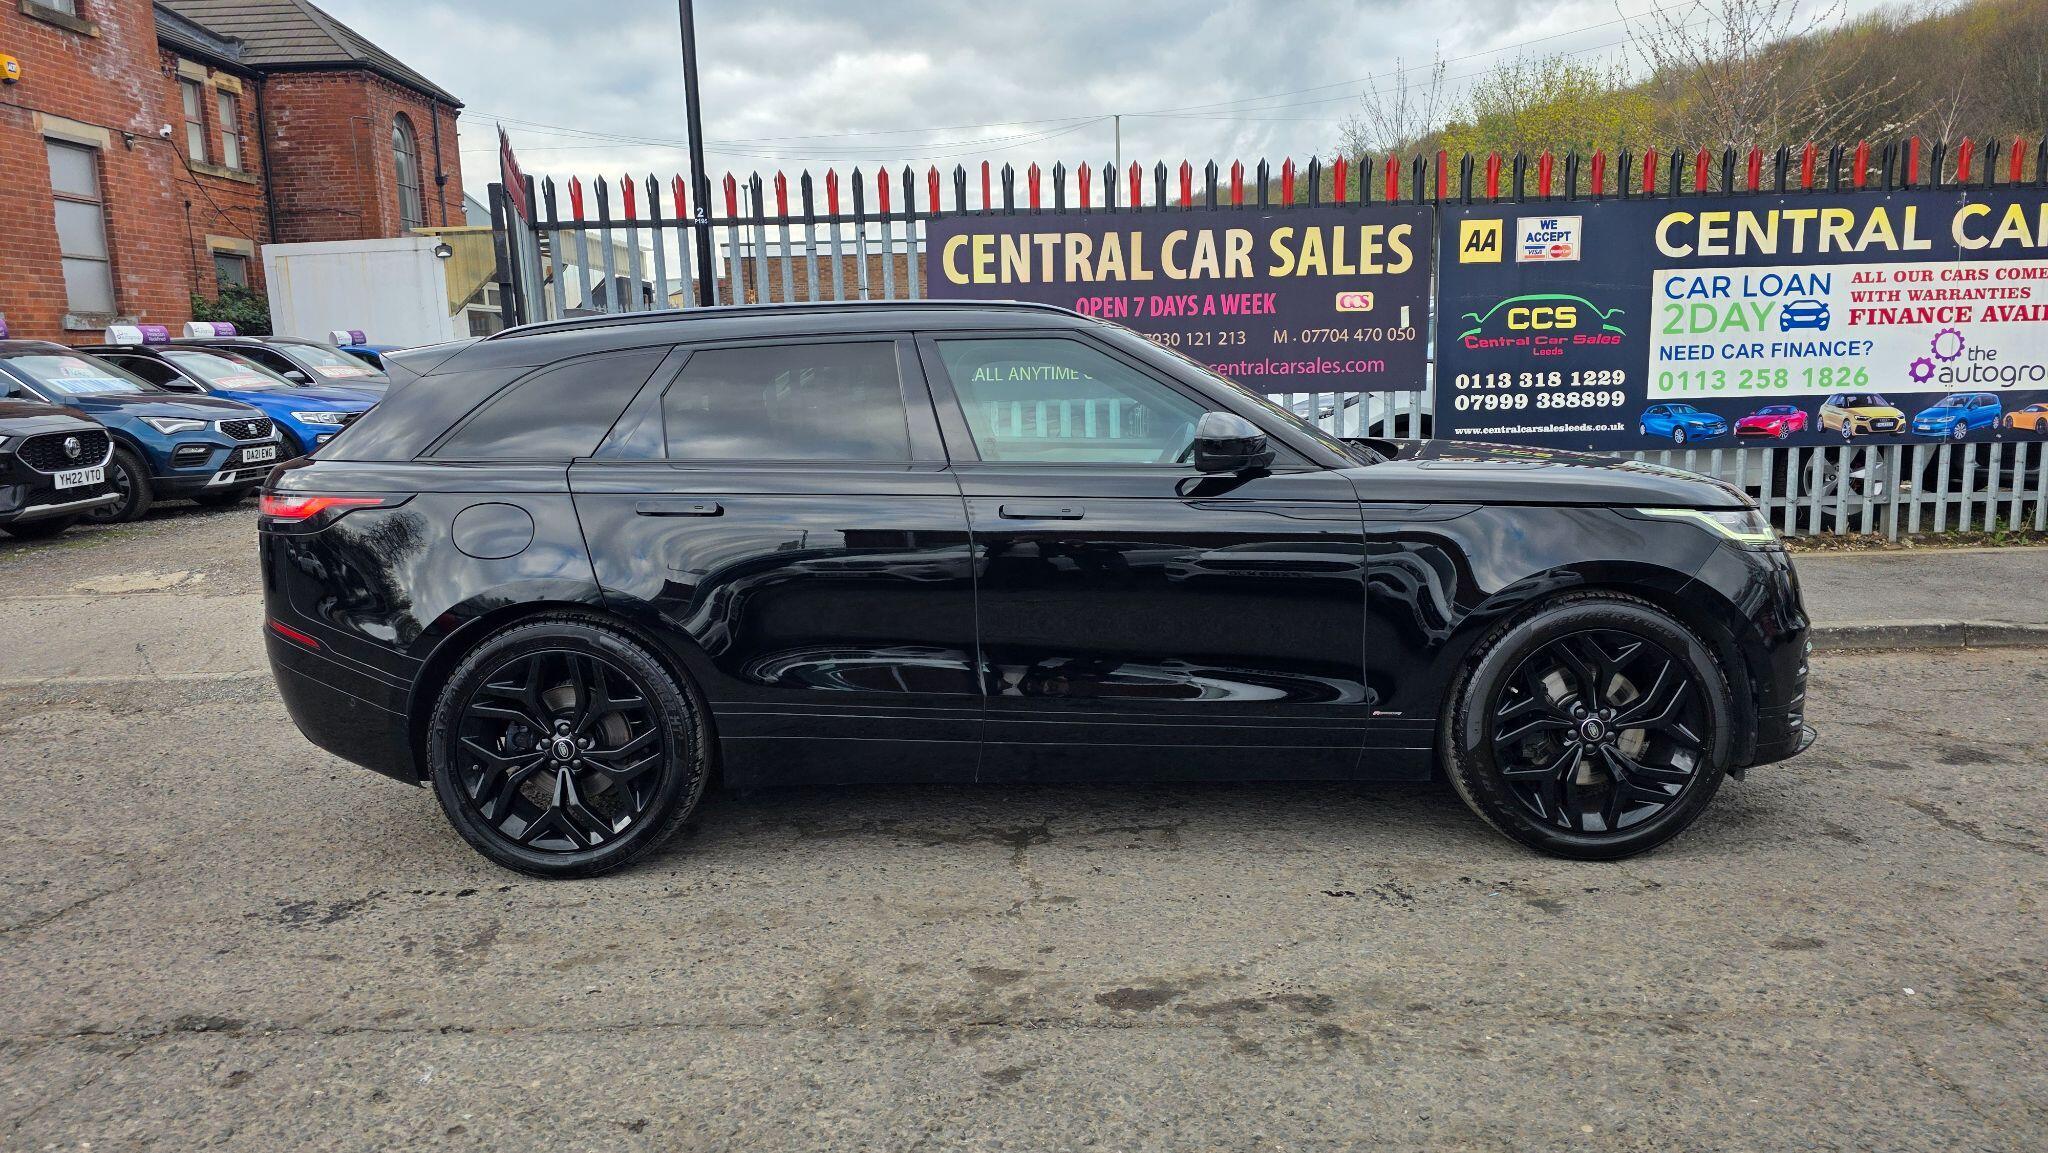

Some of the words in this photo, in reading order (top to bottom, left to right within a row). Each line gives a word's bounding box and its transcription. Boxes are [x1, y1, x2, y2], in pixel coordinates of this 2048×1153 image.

[697, 207, 704, 218] 2
[1540, 220, 1558, 230] WE
[1655, 206, 1931, 258] CENTRAL
[1464, 229, 1496, 252] AA
[1526, 231, 1572, 242] ACCEPT
[942, 231, 1154, 284] CENTRAL
[1161, 228, 1254, 280] CAR
[1268, 224, 1413, 277] SALES
[1851, 271, 1887, 284] ALL
[1893, 270, 1935, 283] OUR
[1940, 268, 1989, 282] CARS
[1995, 267, 2048, 280] COME
[1665, 275, 1731, 300] CAR
[1743, 272, 1831, 298] LOAN
[1850, 290, 1902, 303] WITH
[1907, 287, 2031, 301] WARRANTIES
[1075, 296, 1128, 318] OPEN
[1133, 297, 1145, 317] 7
[1150, 294, 1198, 317] DAYS
[1202, 294, 1216, 316] A
[1220, 292, 1277, 315] WEEK
[1507, 306, 1577, 330] CCS
[1662, 301, 1776, 335] 2DAY
[1848, 306, 1973, 326] FINANCE
[1187, 332, 1211, 346] 121
[1218, 331, 1246, 345] 213
[1302, 329, 1349, 343] 07704
[1354, 328, 1382, 342] 470
[1387, 327, 1416, 341] 050
[1464, 335, 1530, 349] Central
[1535, 335, 1569, 345] Car
[1573, 333, 1621, 345] Sales
[1533, 347, 1564, 356] Leeds
[1659, 344, 1715, 361] NEED
[1721, 343, 1765, 359] CAR
[1771, 340, 1874, 358] FINANCE?
[1968, 345, 1997, 361] the
[971, 367, 1003, 382] ALL
[1008, 366, 1080, 381] ANYTIME
[1455, 372, 1512, 389] 0113
[1519, 371, 1562, 388] 318
[1570, 369, 1626, 386] 1229
[1658, 369, 1726, 392] 0113
[1738, 367, 1789, 390] 258
[1801, 366, 1869, 388] 1826
[1938, 363, 2048, 388] autogro
[1454, 393, 1528, 411] 07999
[1536, 390, 1626, 409] 388899
[1454, 422, 1625, 435] www.centralcarsalesleeds.co.uk
[60, 471, 83, 486] YH22
[85, 469, 101, 482] VTO
